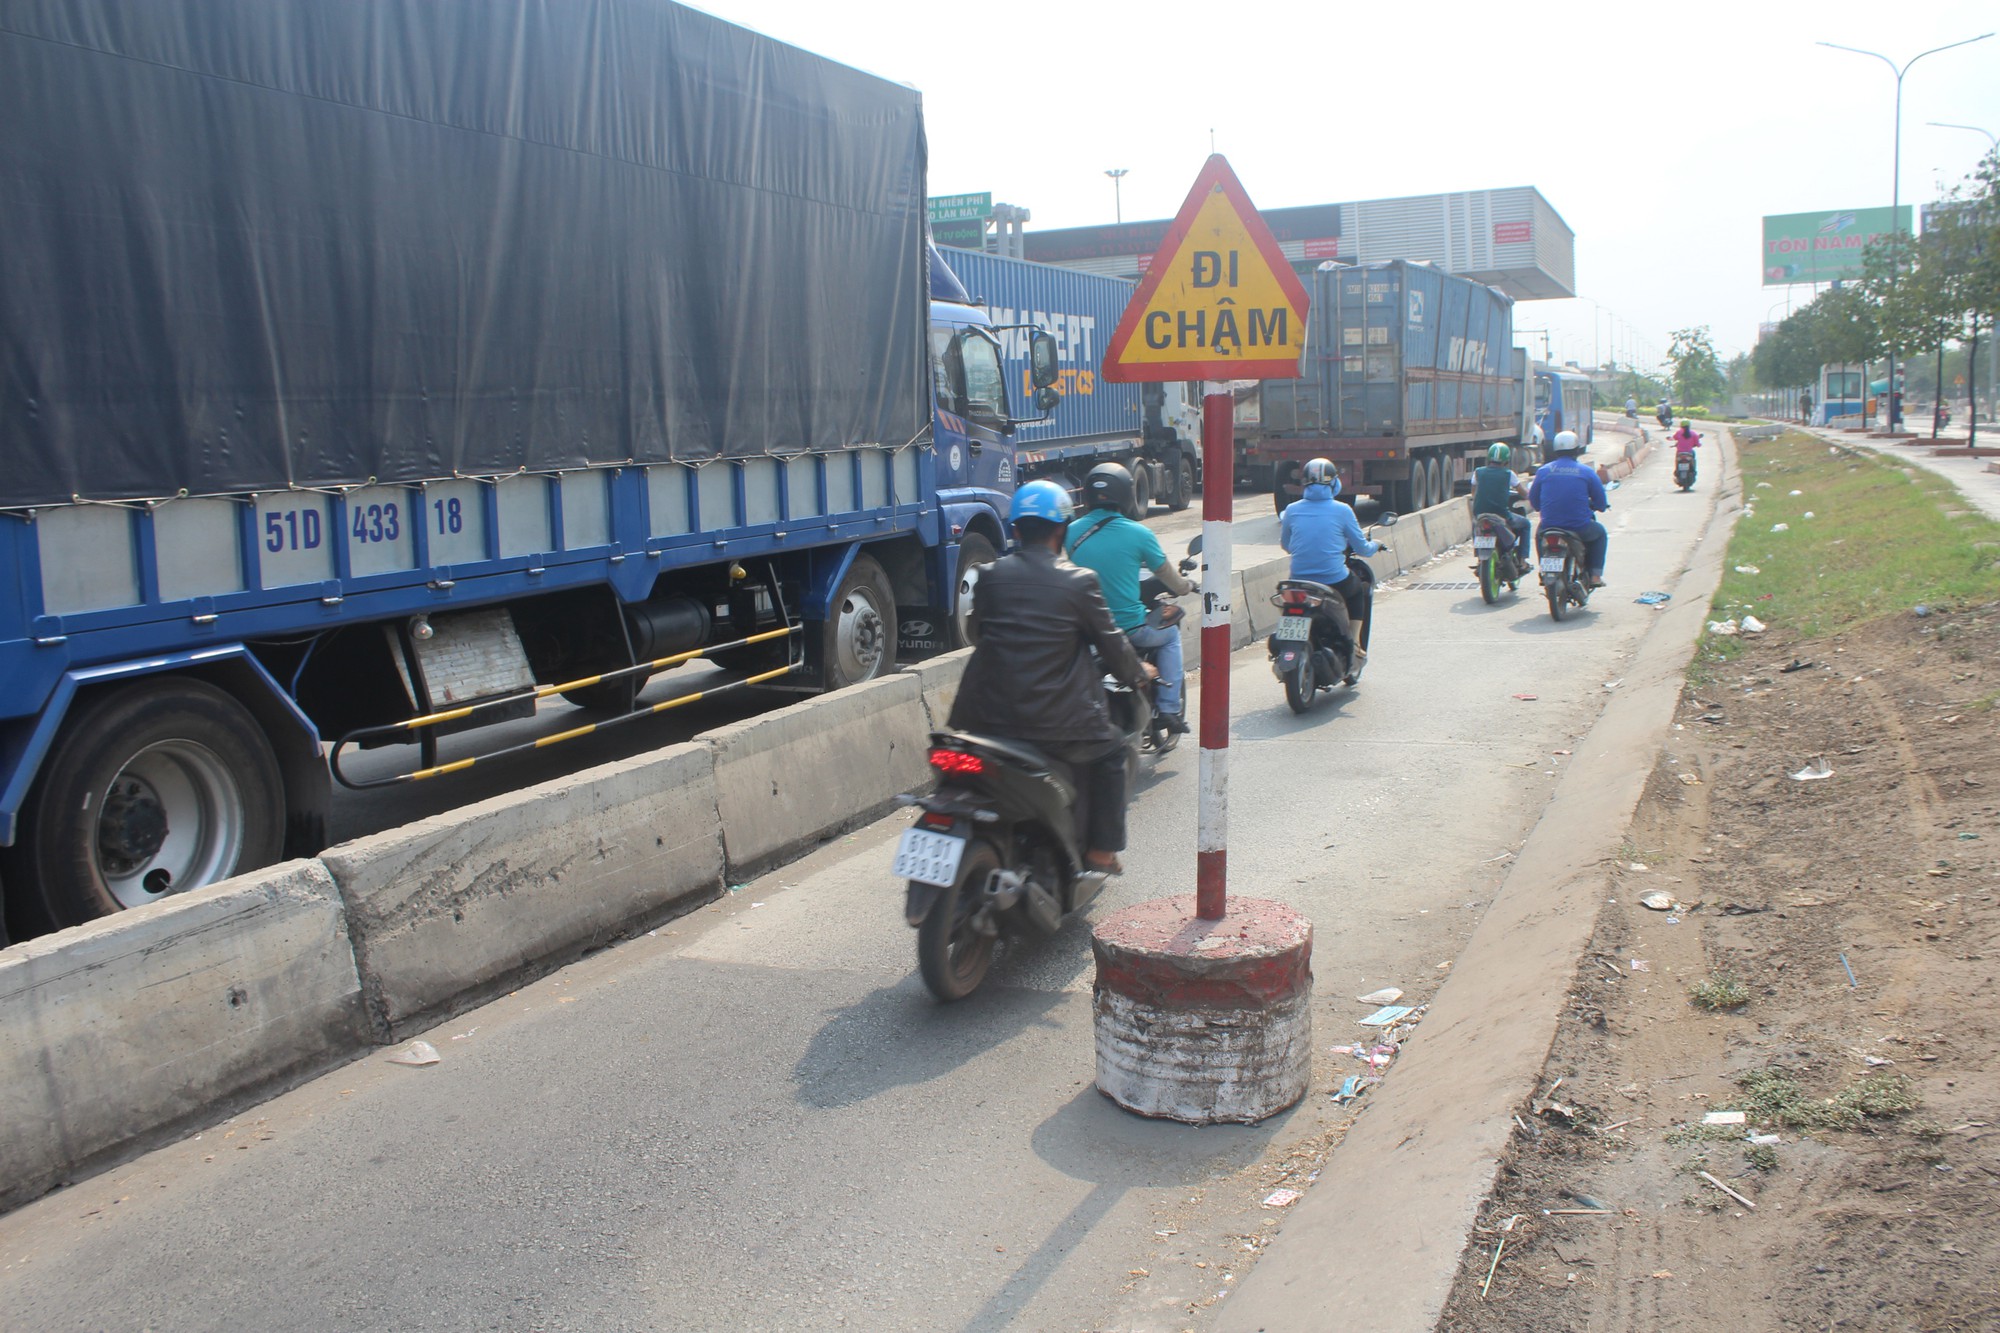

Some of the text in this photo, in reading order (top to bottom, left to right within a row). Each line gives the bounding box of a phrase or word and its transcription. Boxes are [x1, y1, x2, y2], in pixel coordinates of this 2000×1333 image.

[928, 197, 936, 209] HÍ
[966, 193, 983, 205] PHÍ
[939, 208, 957, 219] LÀN
[960, 206, 978, 217] NÀY
[1768, 235, 1808, 254] TÔN
[1813, 234, 1862, 251] NAM
[1191, 250, 1238, 288] ĐI
[1145, 297, 1287, 355] CHẬM
[265, 498, 463, 553] 51D 433 18
